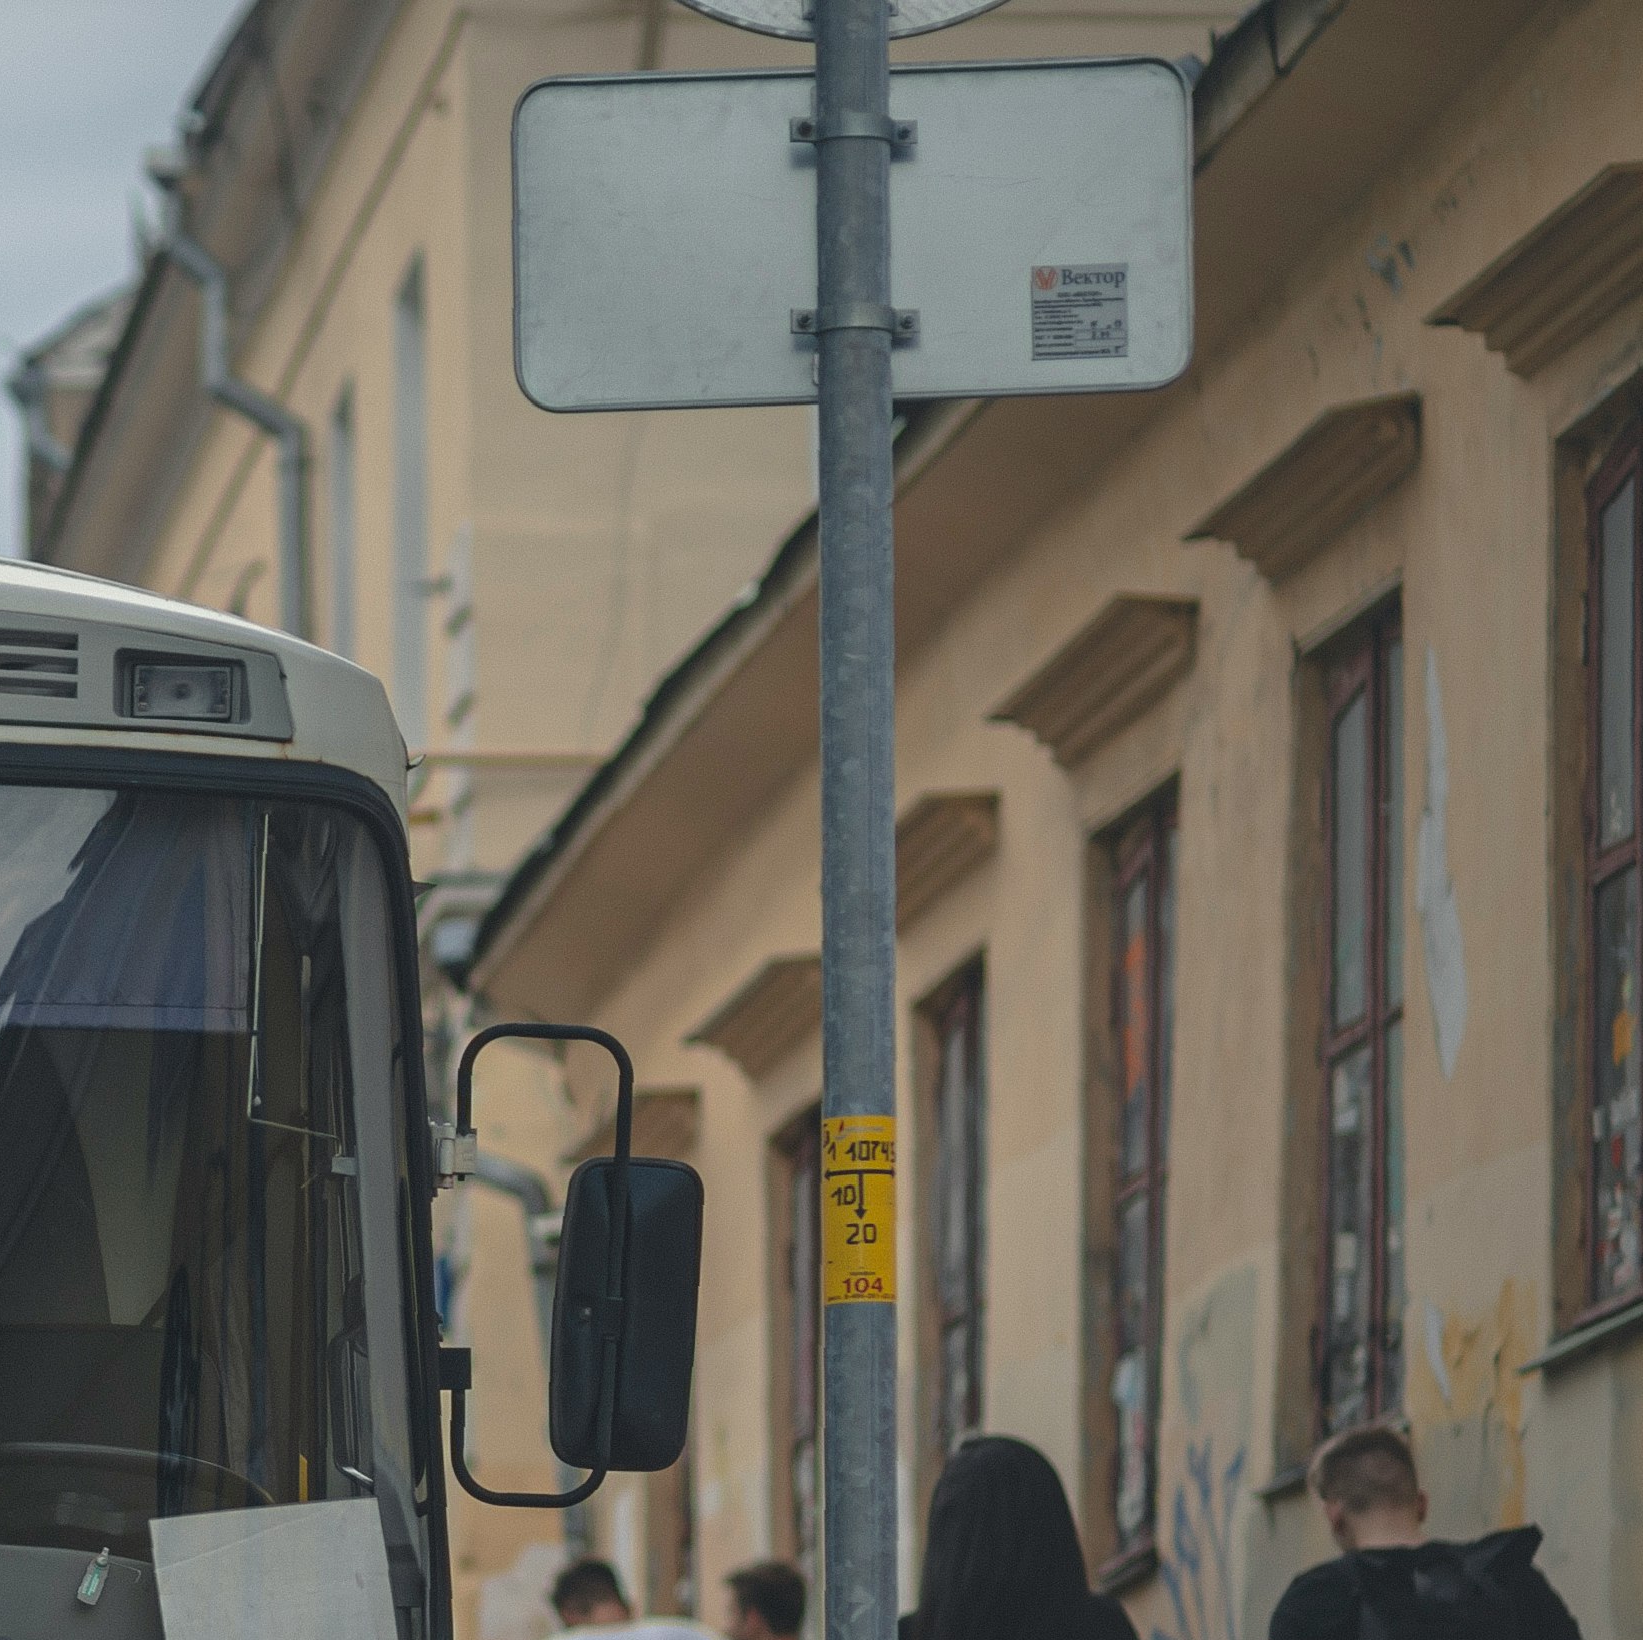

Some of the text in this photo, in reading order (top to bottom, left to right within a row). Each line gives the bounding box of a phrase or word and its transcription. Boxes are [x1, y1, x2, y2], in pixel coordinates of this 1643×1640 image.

[1060, 268, 1125, 288] Вектор
[845, 1223, 877, 1245] 20
[842, 1277, 884, 1293] 104
